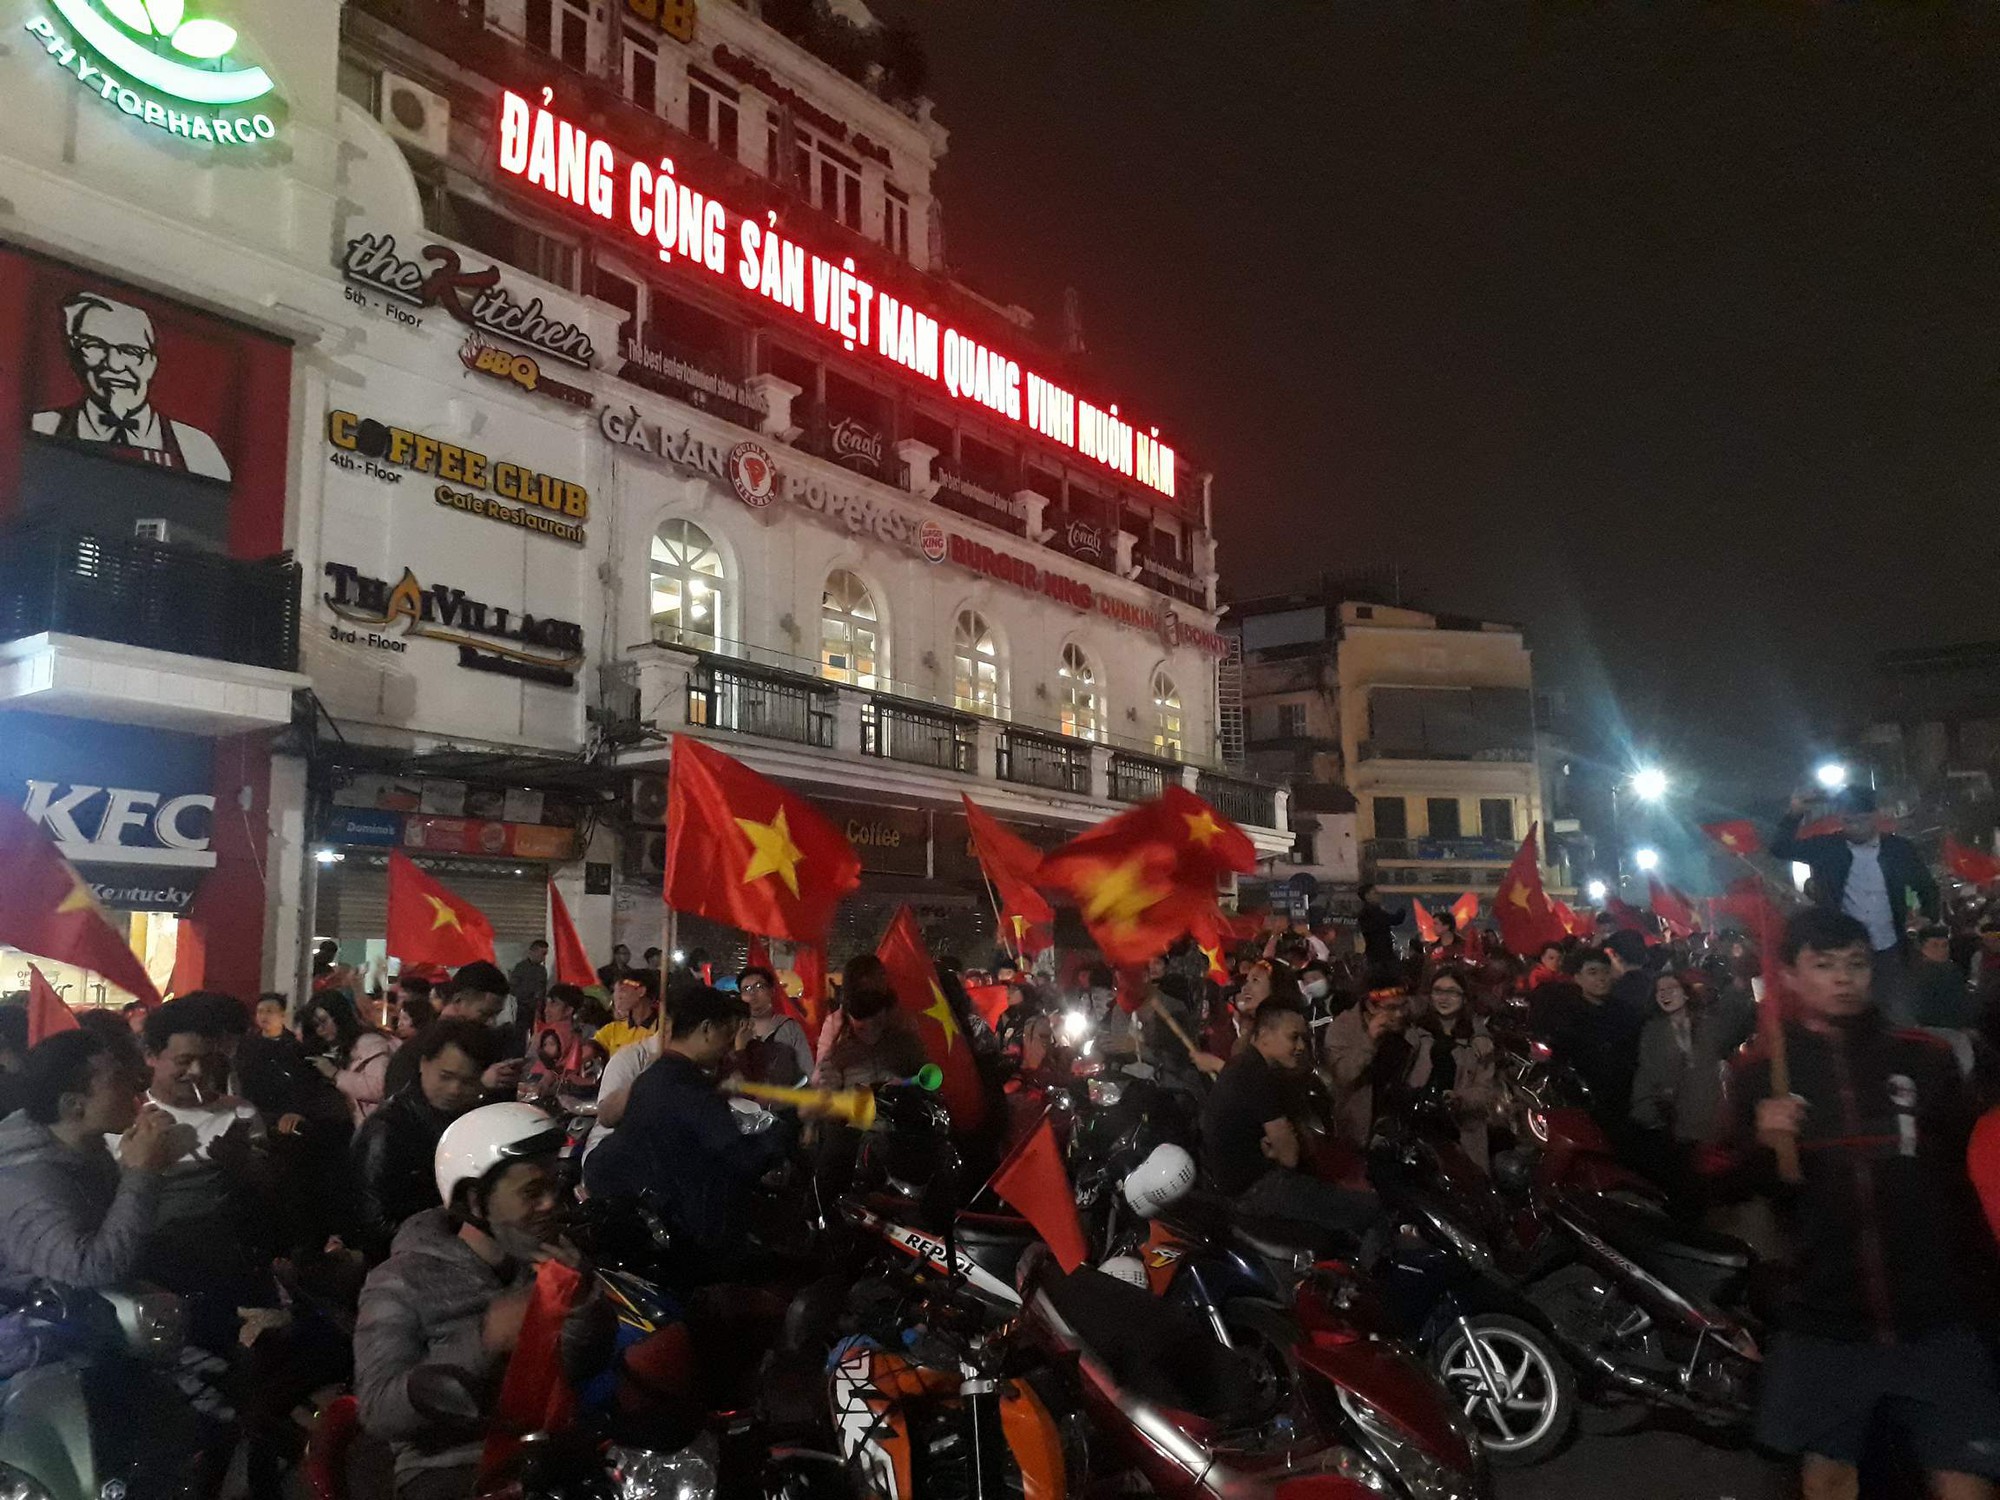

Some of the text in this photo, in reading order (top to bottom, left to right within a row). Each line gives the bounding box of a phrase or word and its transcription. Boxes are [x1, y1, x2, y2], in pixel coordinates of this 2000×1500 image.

[344, 233, 596, 362] the Kitchen
[344, 287, 366, 307] 5th
[386, 304, 424, 328] Floor
[500, 87, 613, 219] ĐẢNG
[630, 157, 725, 274] CỘNG
[739, 210, 804, 313] SẢN
[812, 257, 873, 351] VIỆT
[879, 292, 938, 380] NAM
[944, 328, 1020, 420] QUANG
[1027, 371, 1074, 448] VINH
[1079, 400, 1132, 476] MUÔN
[1137, 426, 1175, 497] NĂM
[475, 348, 541, 391] BBQ
[600, 405, 723, 479] GÀ RÁN
[330, 452, 354, 470] 4th
[365, 462, 403, 484] Floor
[494, 462, 588, 518] CLUB
[435, 485, 585, 543] Cafe Restaurant
[922, 537, 944, 549] KING
[330, 626, 356, 644] 3rd
[369, 633, 408, 653] Floor
[23, 779, 216, 850] KFC
[846, 819, 900, 848] Coffee
